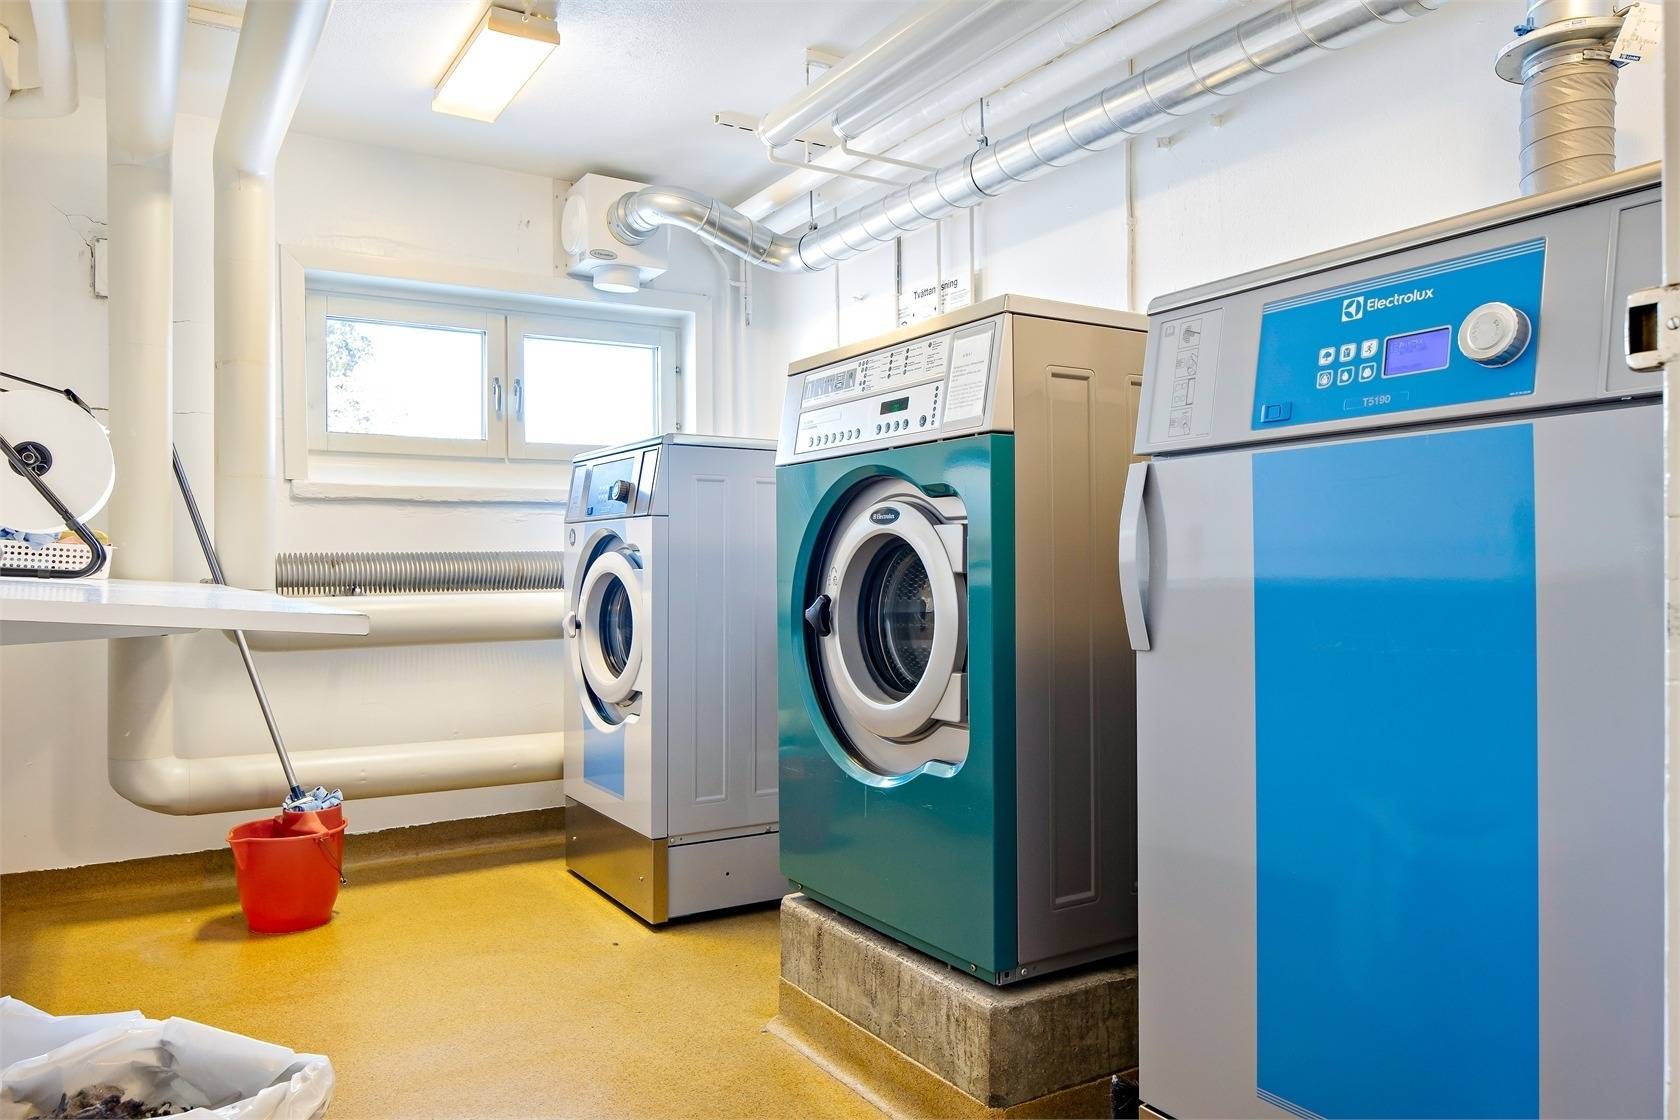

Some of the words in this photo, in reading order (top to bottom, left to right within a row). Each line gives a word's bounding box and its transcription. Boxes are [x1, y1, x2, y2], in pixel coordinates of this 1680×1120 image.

[913, 279, 959, 300] Tvättansning
[1366, 288, 1434, 311] Electrolux
[1362, 394, 1391, 407] T5190
